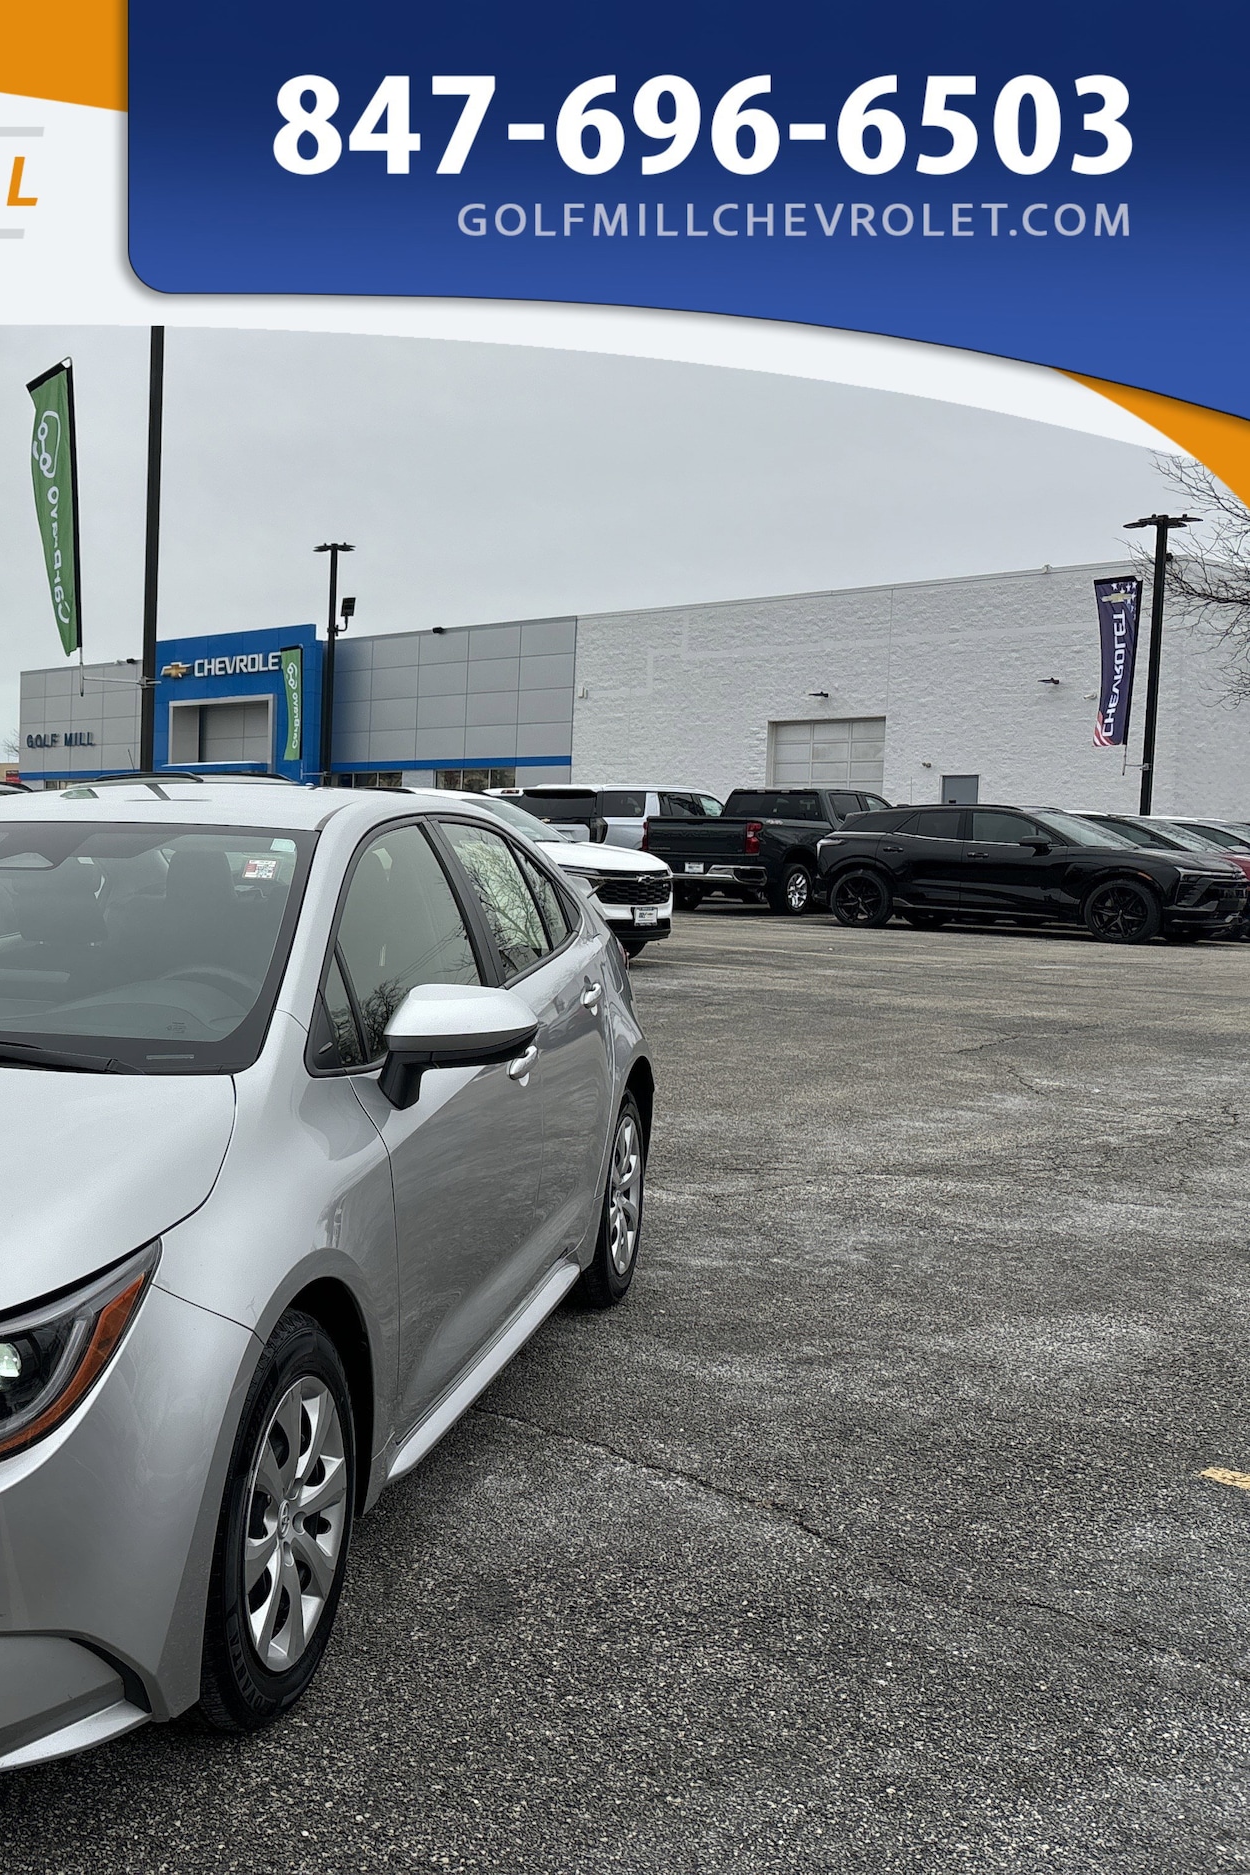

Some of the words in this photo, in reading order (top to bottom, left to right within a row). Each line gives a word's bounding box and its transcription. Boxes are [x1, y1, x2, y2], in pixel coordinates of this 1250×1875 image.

[194, 651, 283, 678] CHEVROLE
[26, 733, 59, 749] GOLF
[64, 731, 95, 747] MILL
